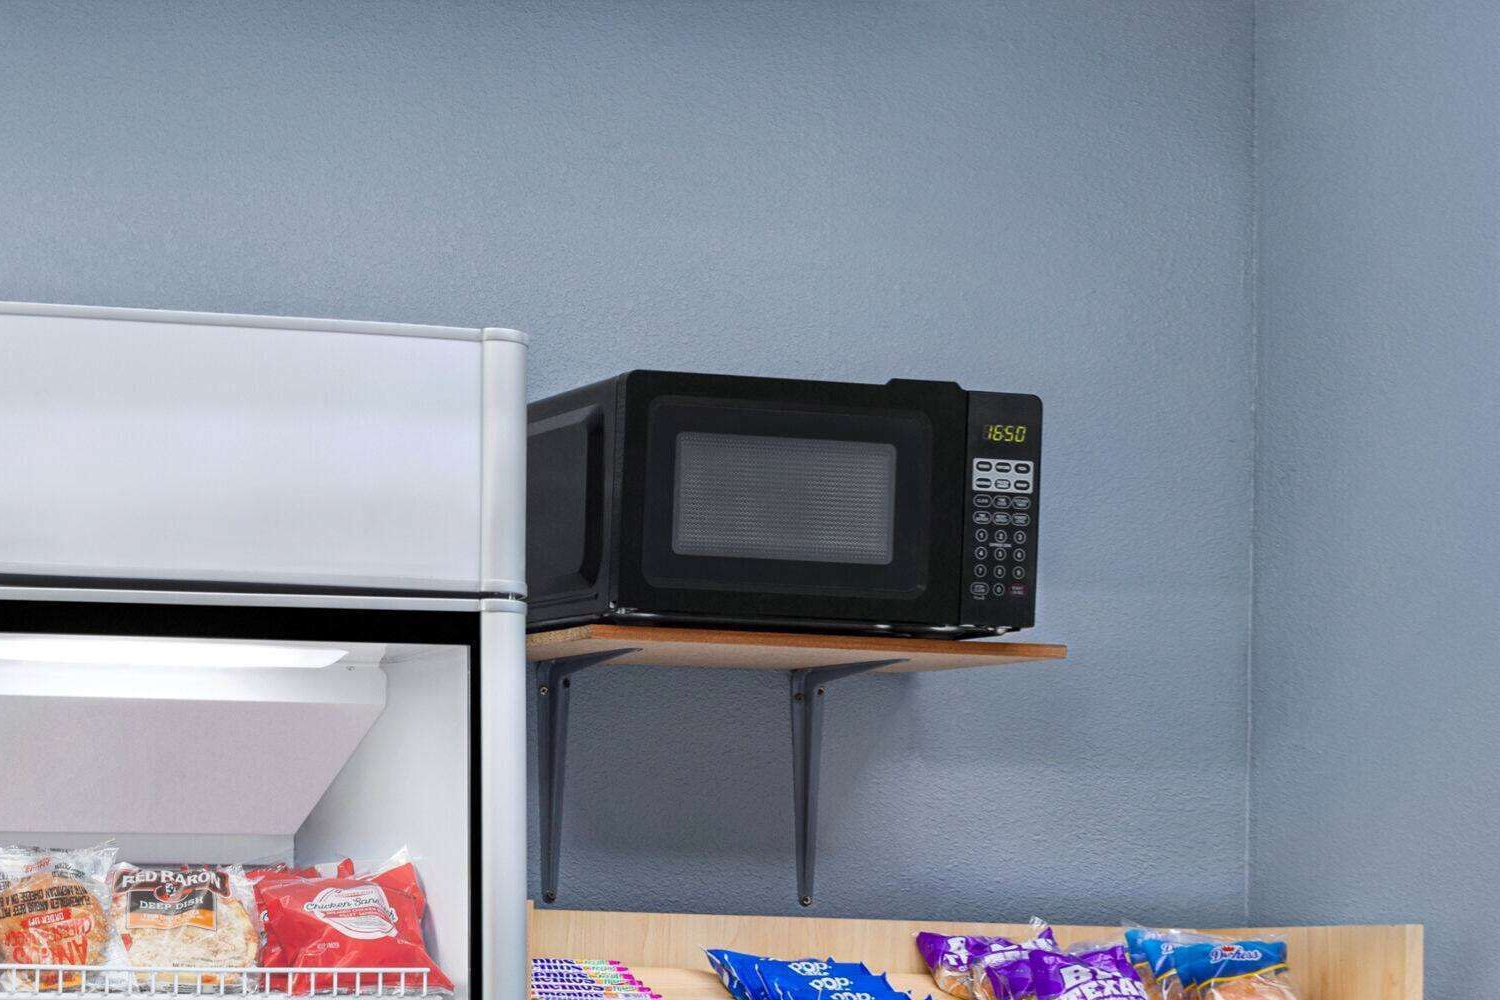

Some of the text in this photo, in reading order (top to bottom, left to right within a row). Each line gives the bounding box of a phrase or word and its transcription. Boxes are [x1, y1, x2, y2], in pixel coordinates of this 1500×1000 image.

[122, 869, 220, 888] RED BARON
[140, 897, 203, 910] DEEP DISH
[305, 900, 352, 910] Chicken
[12, 905, 26, 915] BEEF
[42, 912, 64, 923] ORDER
